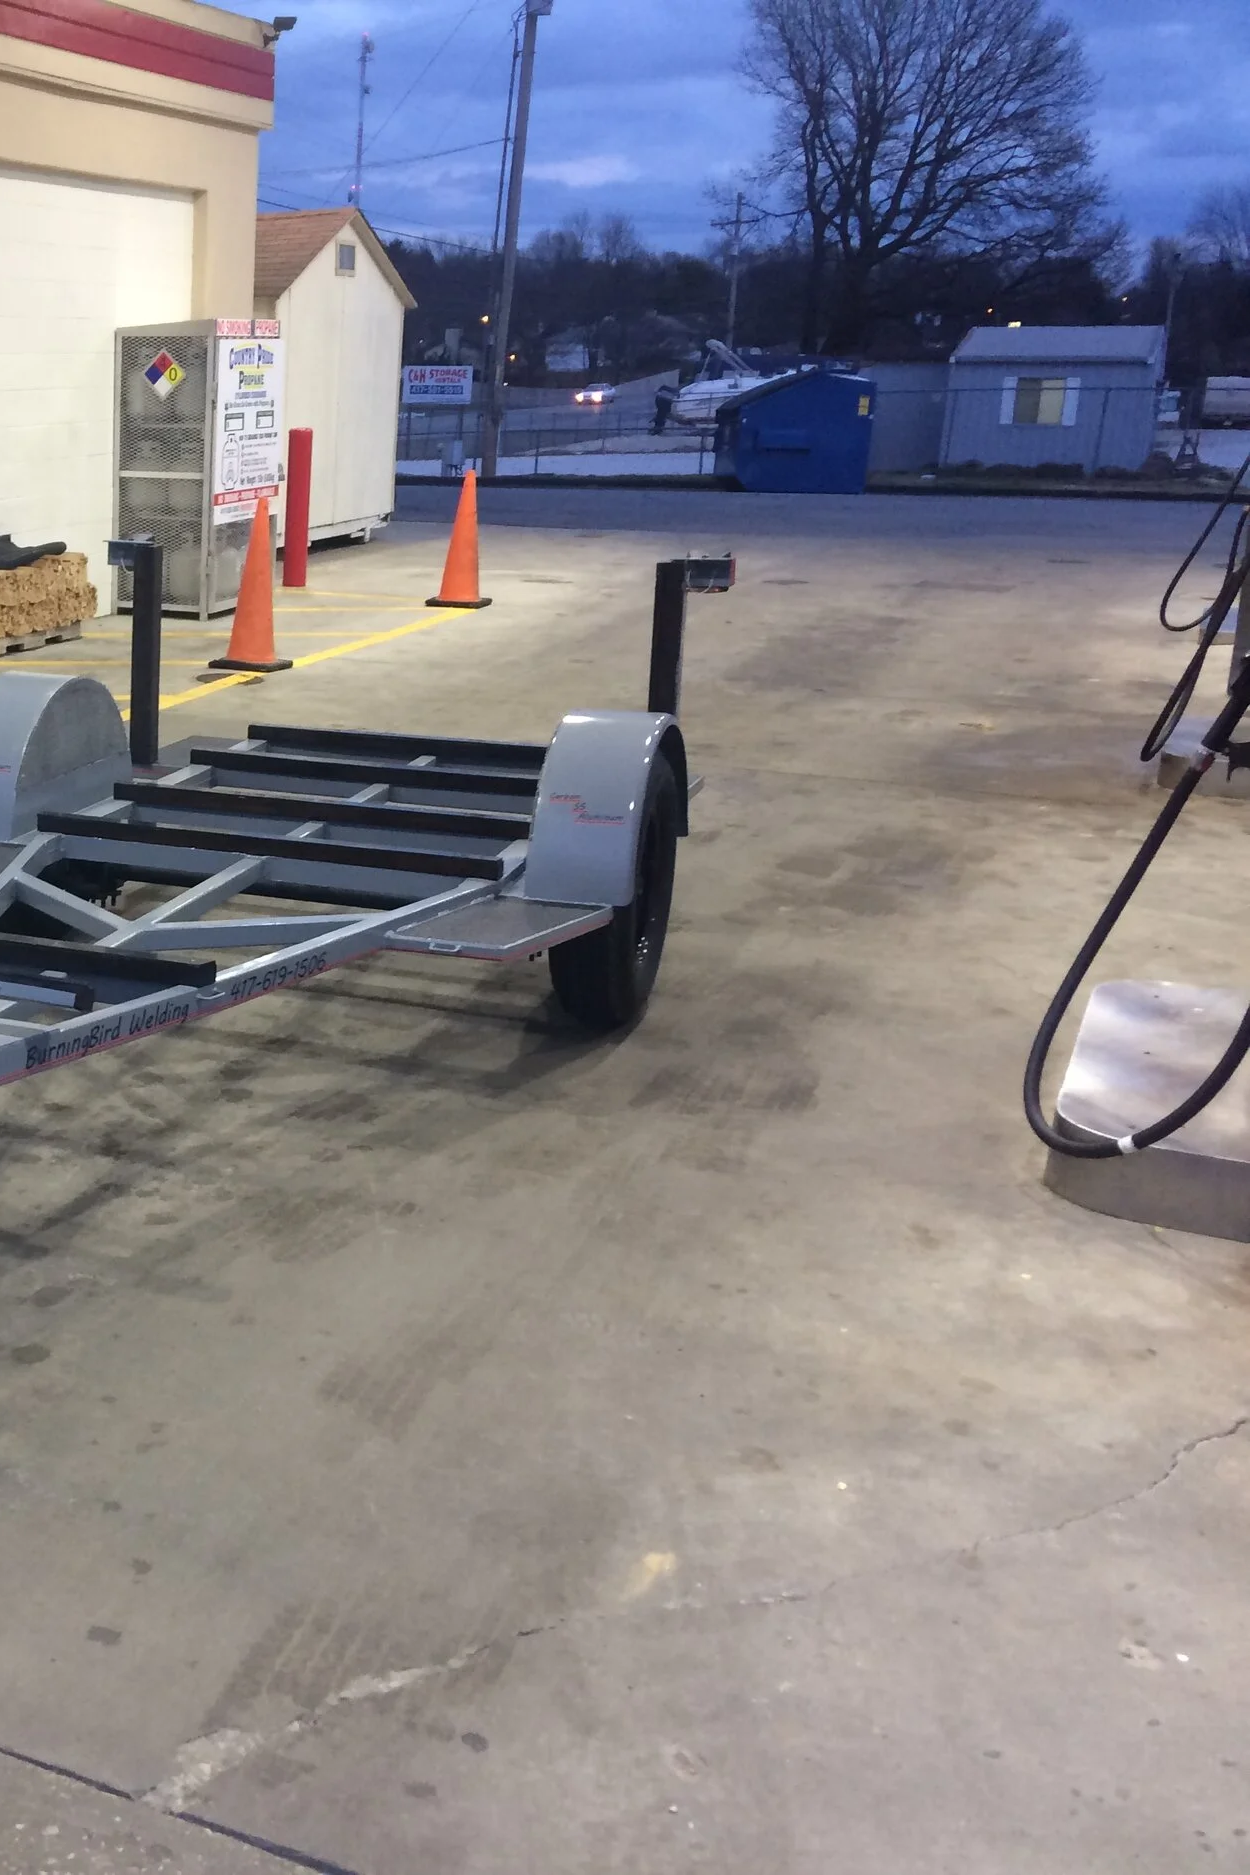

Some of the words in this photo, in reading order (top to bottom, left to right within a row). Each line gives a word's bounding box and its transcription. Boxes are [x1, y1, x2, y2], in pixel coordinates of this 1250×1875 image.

[168, 367, 178, 382] 0
[429, 368, 468, 379] STORAGE
[129, 1001, 190, 1034] Welding
[230, 951, 327, 1001] 417-619-1506
